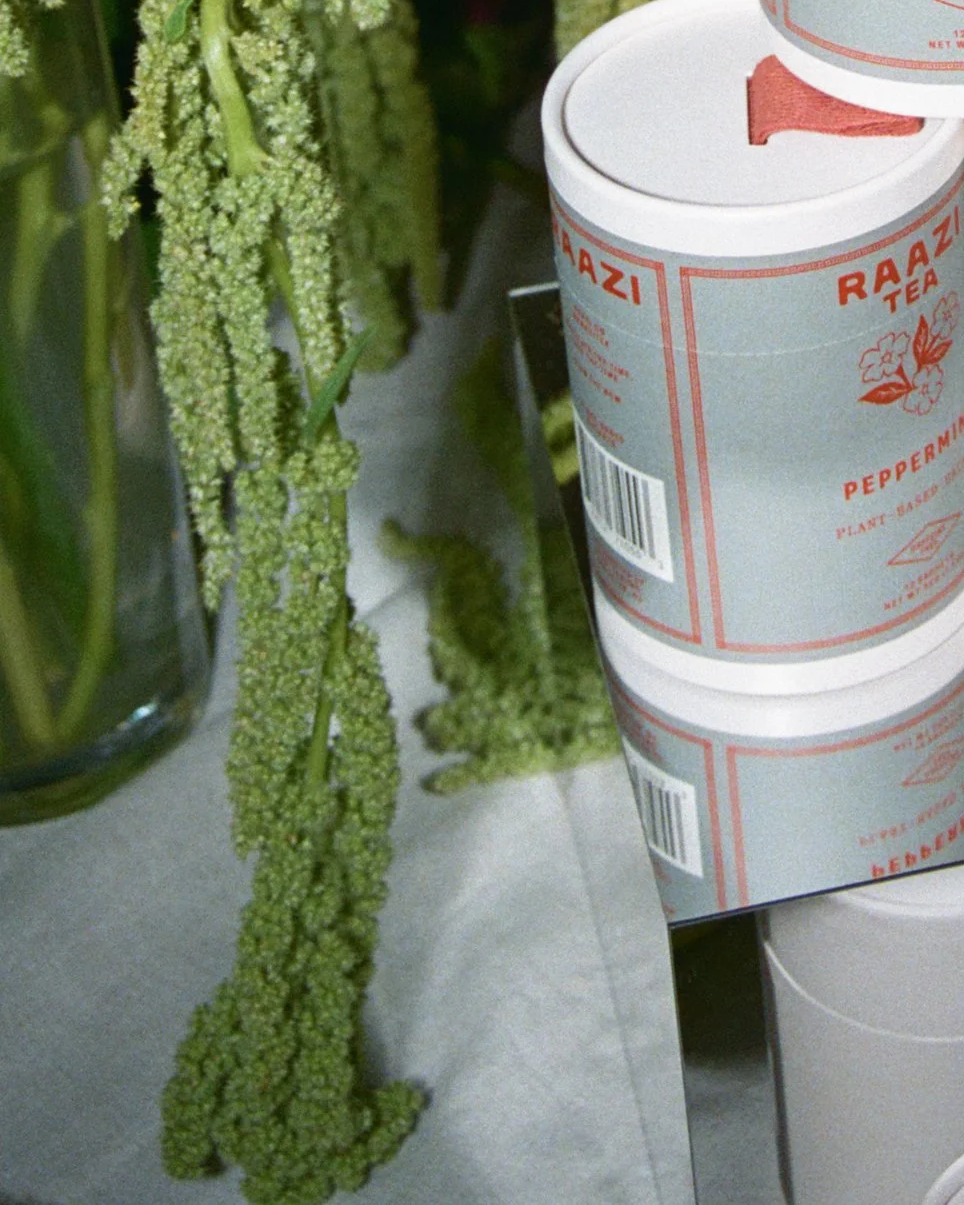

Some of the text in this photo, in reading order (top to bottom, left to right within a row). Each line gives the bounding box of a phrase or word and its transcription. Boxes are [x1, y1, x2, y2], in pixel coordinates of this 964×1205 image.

[928, 40, 951, 49] NET
[837, 205, 960, 306] RAAZI
[882, 267, 938, 314] TEA
